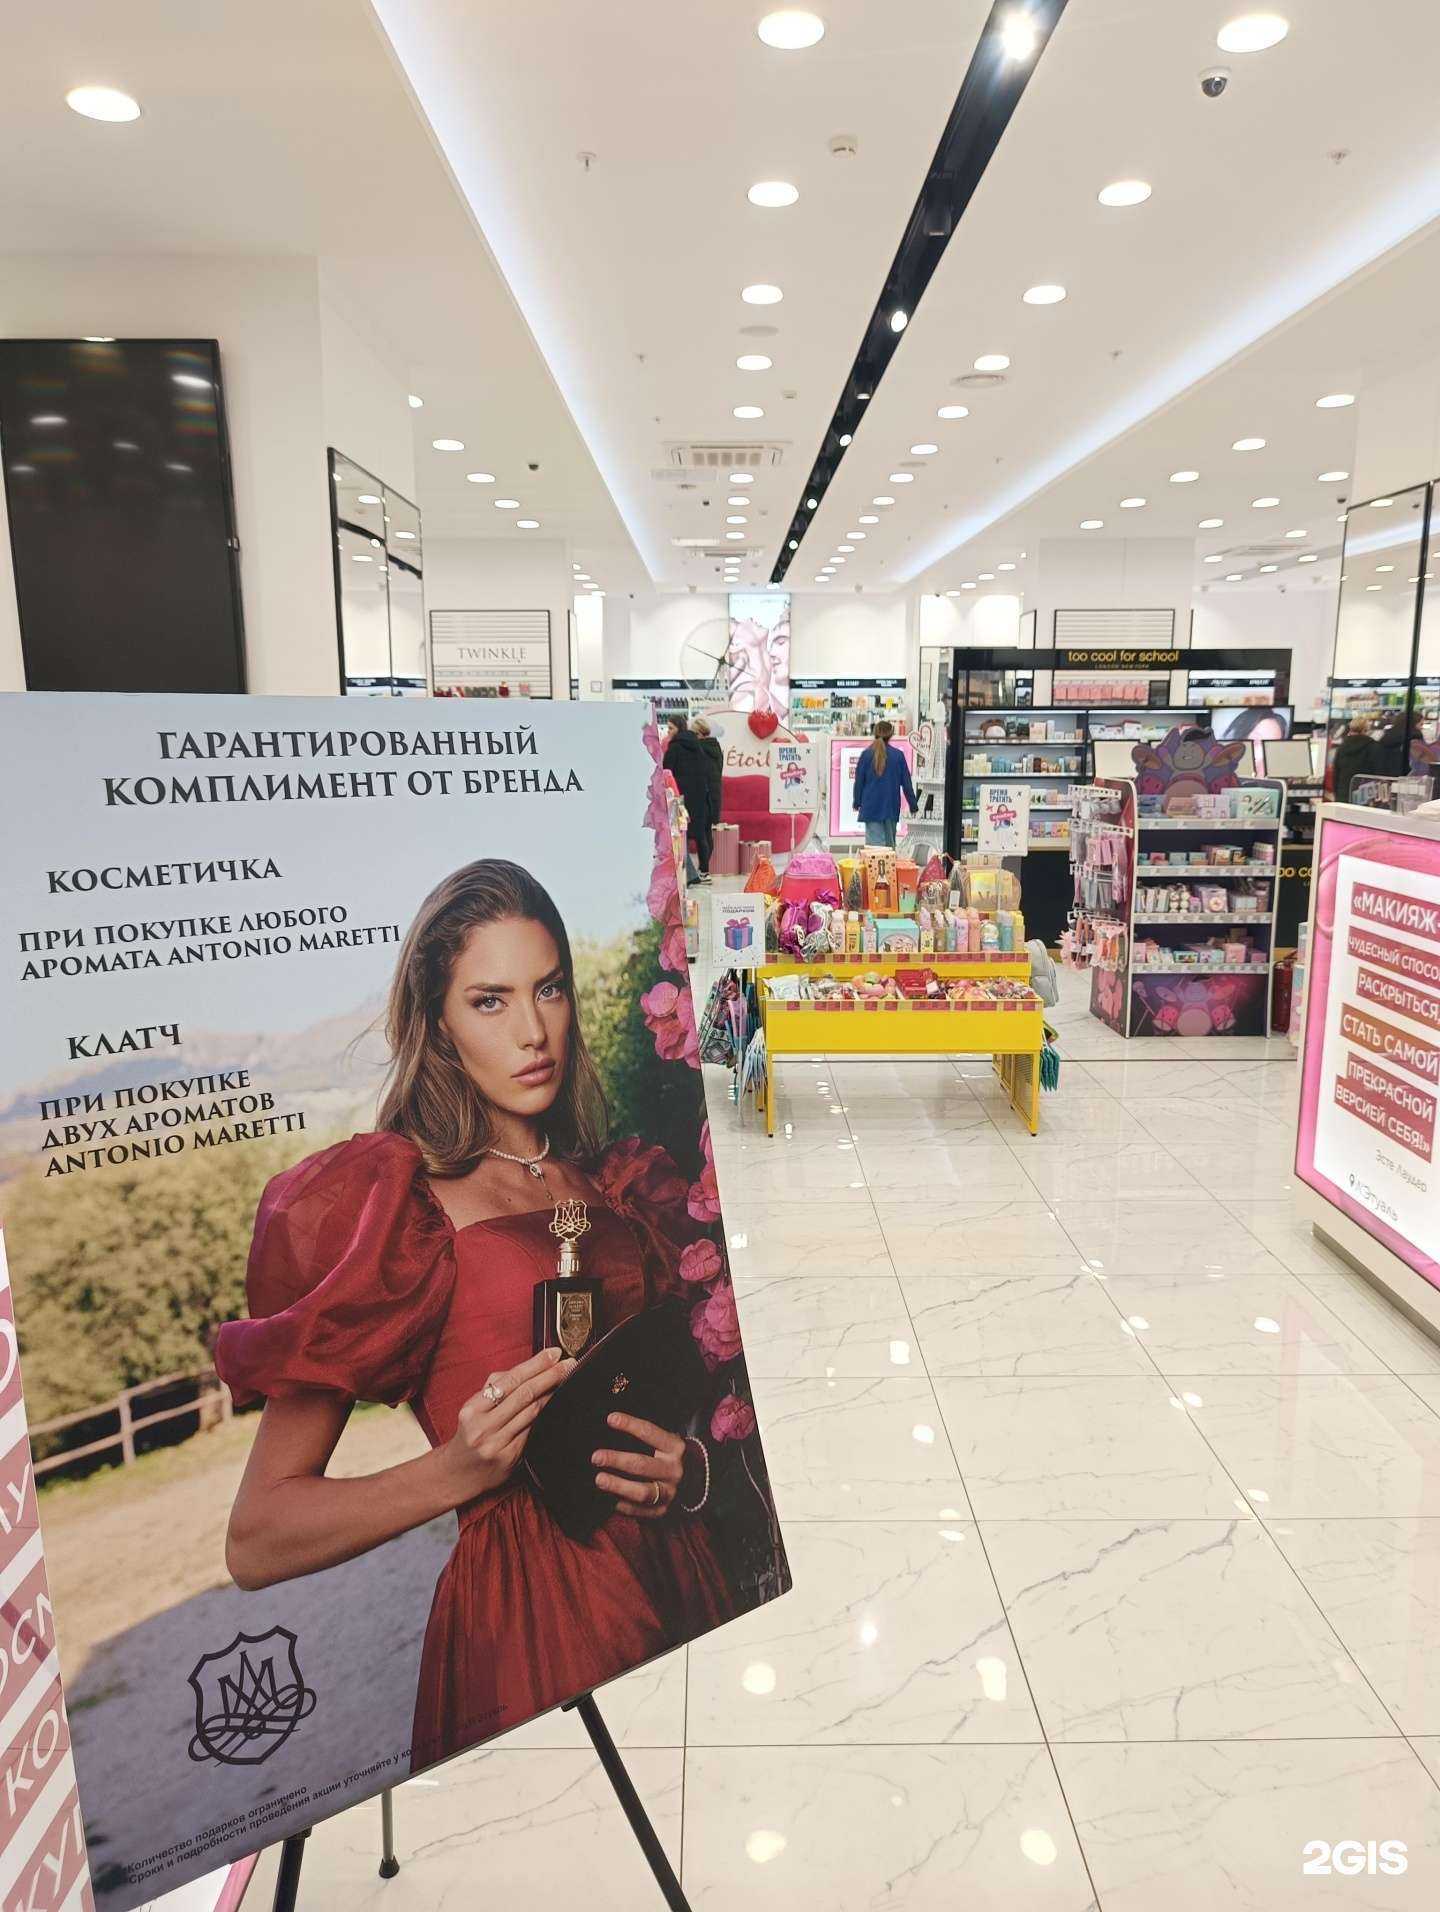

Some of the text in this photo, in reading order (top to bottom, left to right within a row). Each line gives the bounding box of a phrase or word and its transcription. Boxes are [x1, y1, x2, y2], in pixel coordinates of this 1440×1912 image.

[457, 646, 528, 661] TWINKLE
[1068, 651, 1180, 662] too cool for school
[156, 725, 538, 760] ГАРАНТИРОВАННЫЙ
[725, 746, 770, 768] Étoil
[103, 767, 585, 807] КОМПЛИМЕНТ ОТ БРЕНДА
[46, 857, 283, 894] КОСМЕТИЧКА
[18, 904, 348, 954] ПРИ ПОКУПКЕ ЛЮБОГО
[19, 924, 401, 981] АРОМАТА ANTONIO MARETTI
[1349, 938, 1440, 983] ЧУДЕСНЫЙ СПОСО
[67, 1023, 182, 1061] КЛАТЧ
[1343, 1014, 1439, 1076] СТАТЬ САМОЙ
[39, 1068, 252, 1122] ПРИ ПОКУПКЕ
[1335, 1084, 1386, 1127] ВЕРСИЕЙ
[1348, 1061, 1433, 1122] ПРЕКРАСНОЙ
[40, 1091, 275, 1151] ДВУХ АРОМАТОВ
[44, 1111, 307, 1179] ANTONIO MARETTI
[127, 1786, 308, 1874] Количество подарков ограничено
[128, 1861, 165, 1886] Сроки
[167, 1857, 175, 1869] и
[176, 1825, 248, 1864] подробности
[249, 1797, 311, 1832] проведения
[312, 1781, 342, 1802] акции
[343, 1759, 393, 1791] уточняйте
[393, 1752, 401, 1765] у
